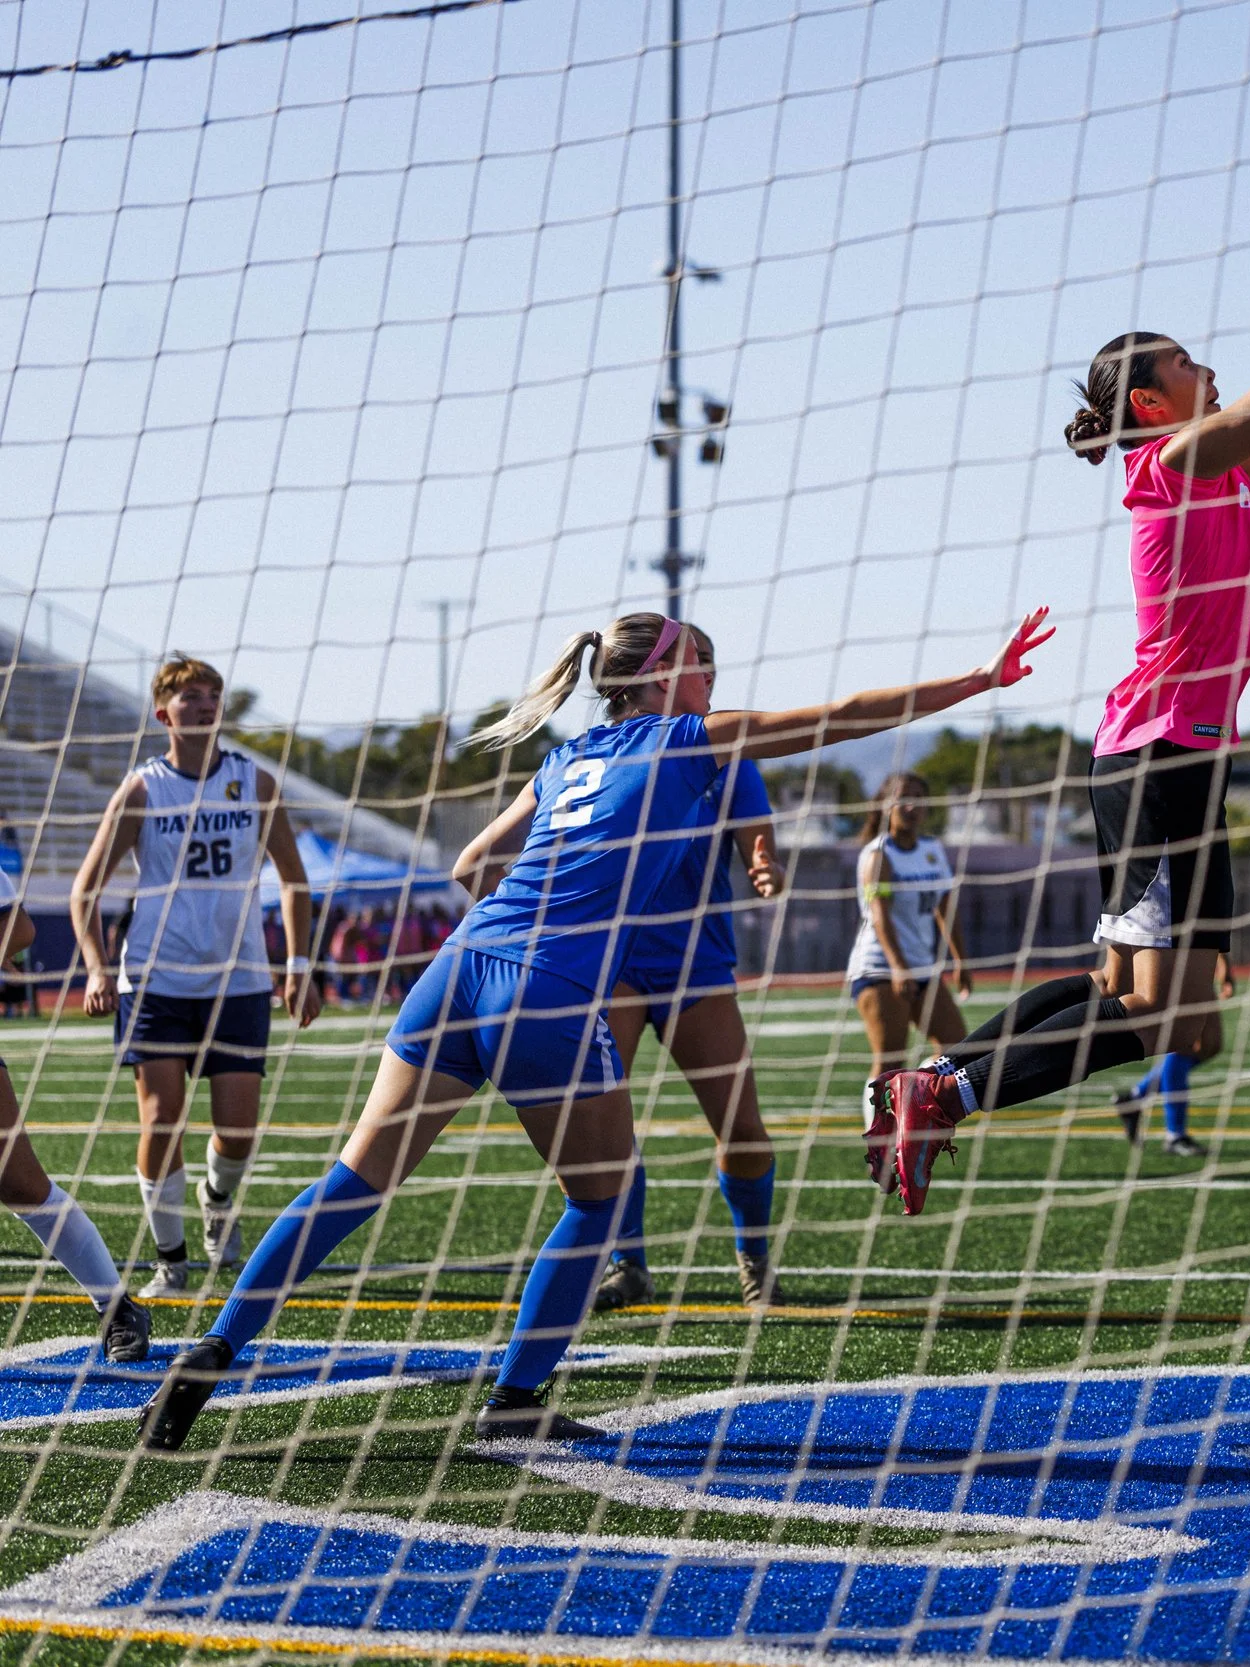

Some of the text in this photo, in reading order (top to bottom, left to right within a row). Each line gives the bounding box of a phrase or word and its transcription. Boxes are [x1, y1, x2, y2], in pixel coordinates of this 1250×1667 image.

[1194, 725, 1219, 734] CANYONS
[549, 758, 607, 830] 2
[187, 838, 232, 879] 26
